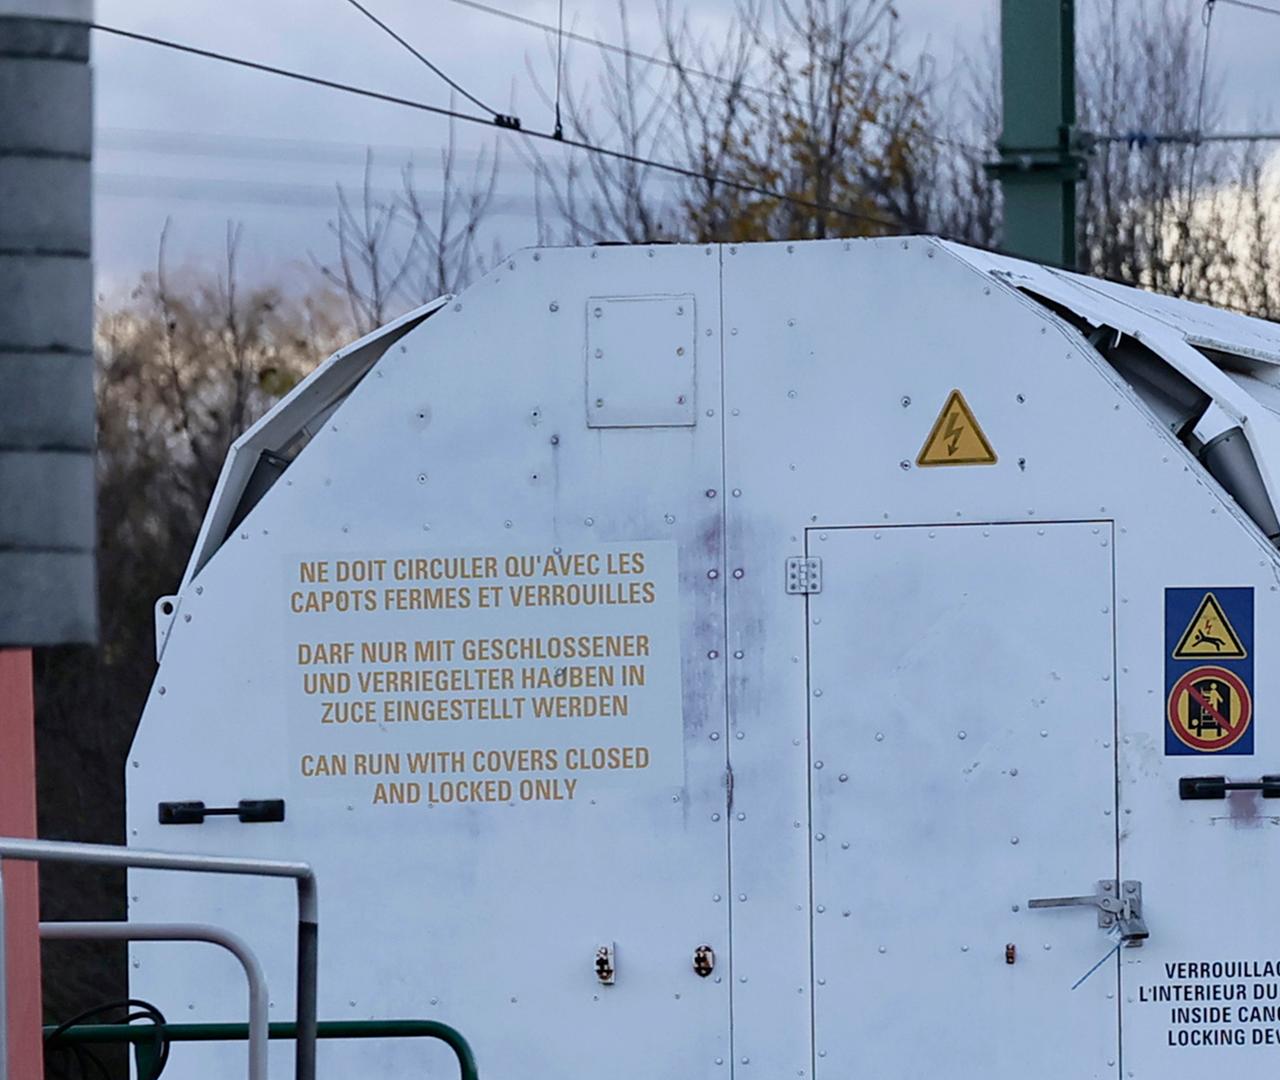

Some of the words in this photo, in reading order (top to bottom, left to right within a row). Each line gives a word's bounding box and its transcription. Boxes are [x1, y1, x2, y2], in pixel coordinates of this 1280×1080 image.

[300, 561, 329, 583] NE
[336, 559, 387, 582] DOIT
[394, 557, 498, 581] CIRCULER
[505, 552, 600, 579] QU'AVEC
[607, 552, 645, 575] LES
[290, 589, 377, 613] CAPOTS
[385, 587, 471, 611] FERMES
[479, 586, 503, 608] ET
[510, 582, 655, 607] VERROUILLES
[298, 642, 354, 665] DARF
[362, 641, 407, 663] NUR
[415, 640, 456, 662] MIT
[462, 635, 650, 661] GESCHLOSSENER
[303, 671, 351, 694] UND
[358, 668, 514, 693] VERRIEGELTER
[622, 665, 645, 686] IN
[321, 701, 377, 724] ZUCE
[384, 697, 526, 722] EINGESTELLT
[533, 695, 628, 718] WERDEN
[301, 754, 347, 776] CAN
[354, 752, 401, 774] RUN
[408, 751, 465, 774] WITH
[472, 748, 558, 772] COVERS
[565, 747, 650, 770] CLOSED
[373, 782, 420, 805] AND
[428, 780, 512, 803] LOCKED
[520, 778, 578, 800] ONLY
[1139, 983, 1247, 1002] L'INTERIEUR
[1253, 983, 1277, 1000] DU
[1171, 1006, 1231, 1023] INSIDE
[1168, 1029, 1245, 1046] LOCKING
